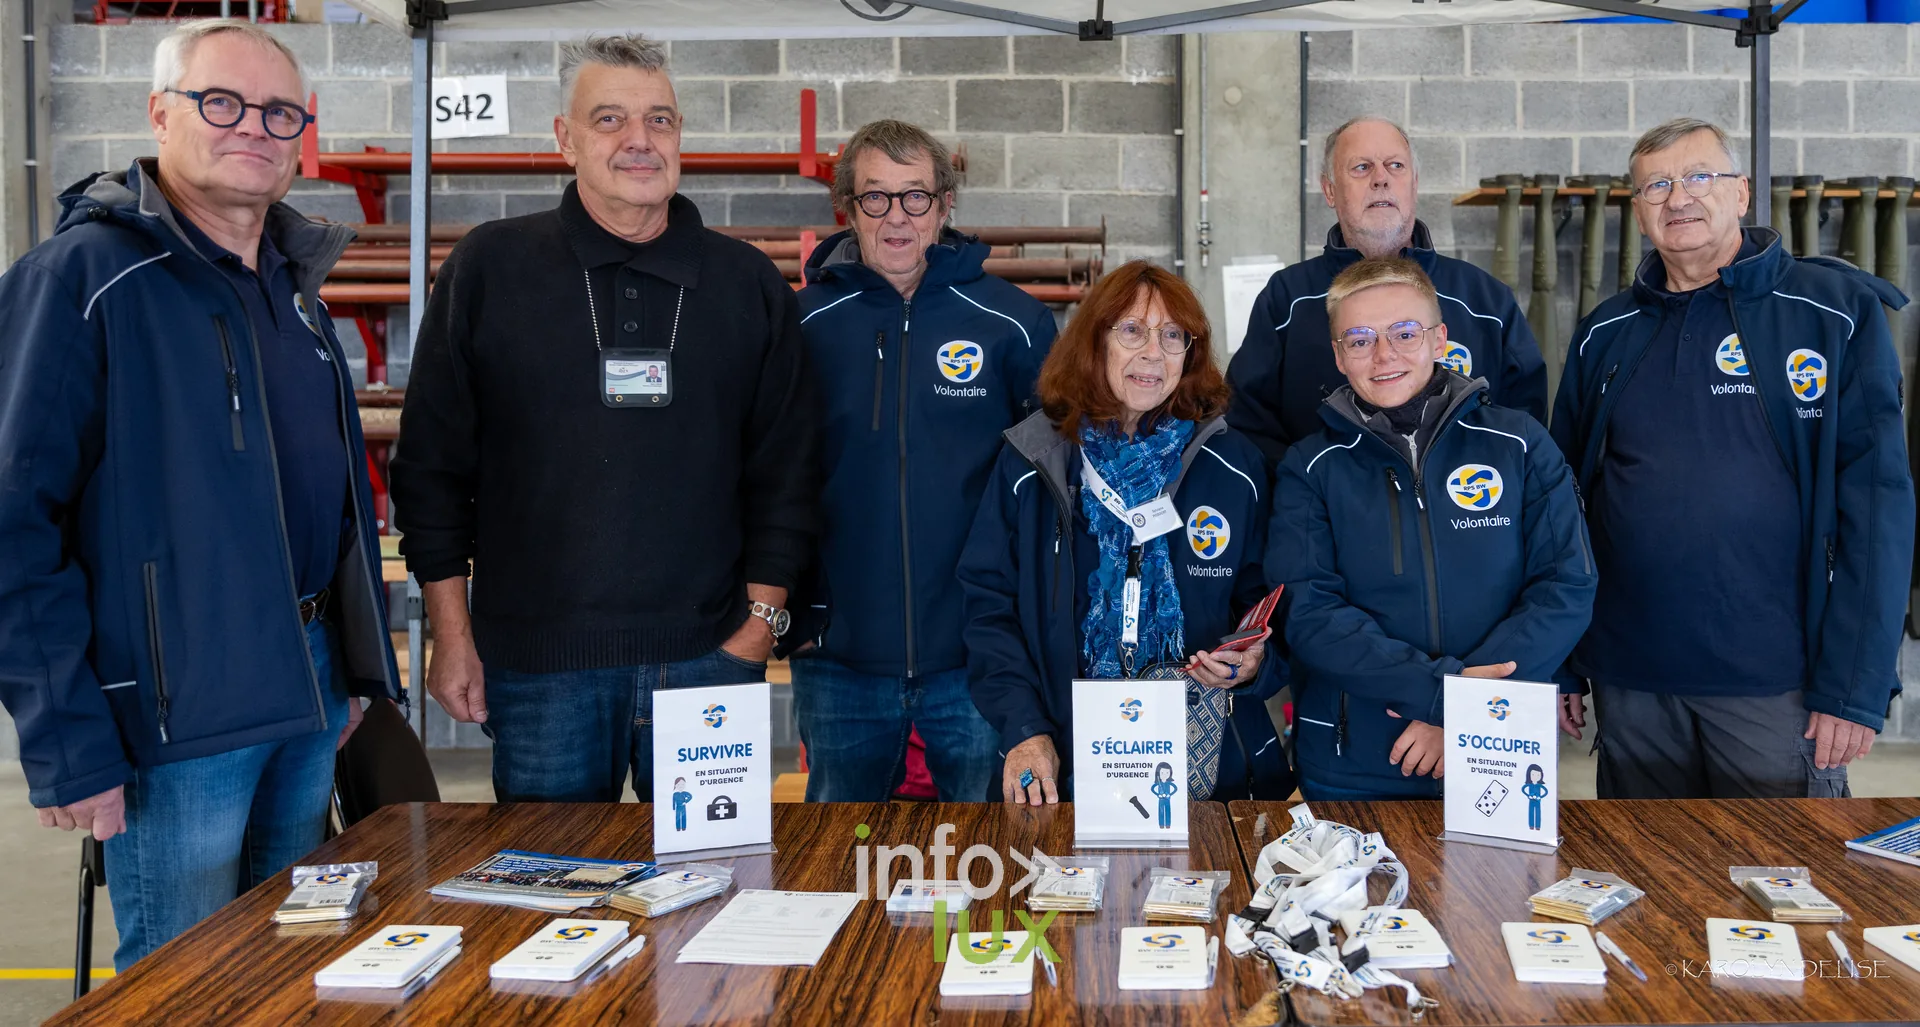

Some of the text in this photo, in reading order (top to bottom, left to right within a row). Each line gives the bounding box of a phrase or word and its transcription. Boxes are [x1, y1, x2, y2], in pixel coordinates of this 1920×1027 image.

[435, 93, 494, 123] S42
[933, 383, 987, 397] Volontaire
[1450, 514, 1511, 530] Volontaire
[1186, 564, 1233, 578] Volontaire
[677, 742, 753, 763] SURVIVRE
[1478, 758, 1517, 768] SITUATION
[695, 766, 748, 777] EN SITUATION
[1106, 771, 1149, 779] D'URGENCE
[1470, 766, 1513, 777] D'URGENCE
[700, 776, 744, 786] D'URGENCE
